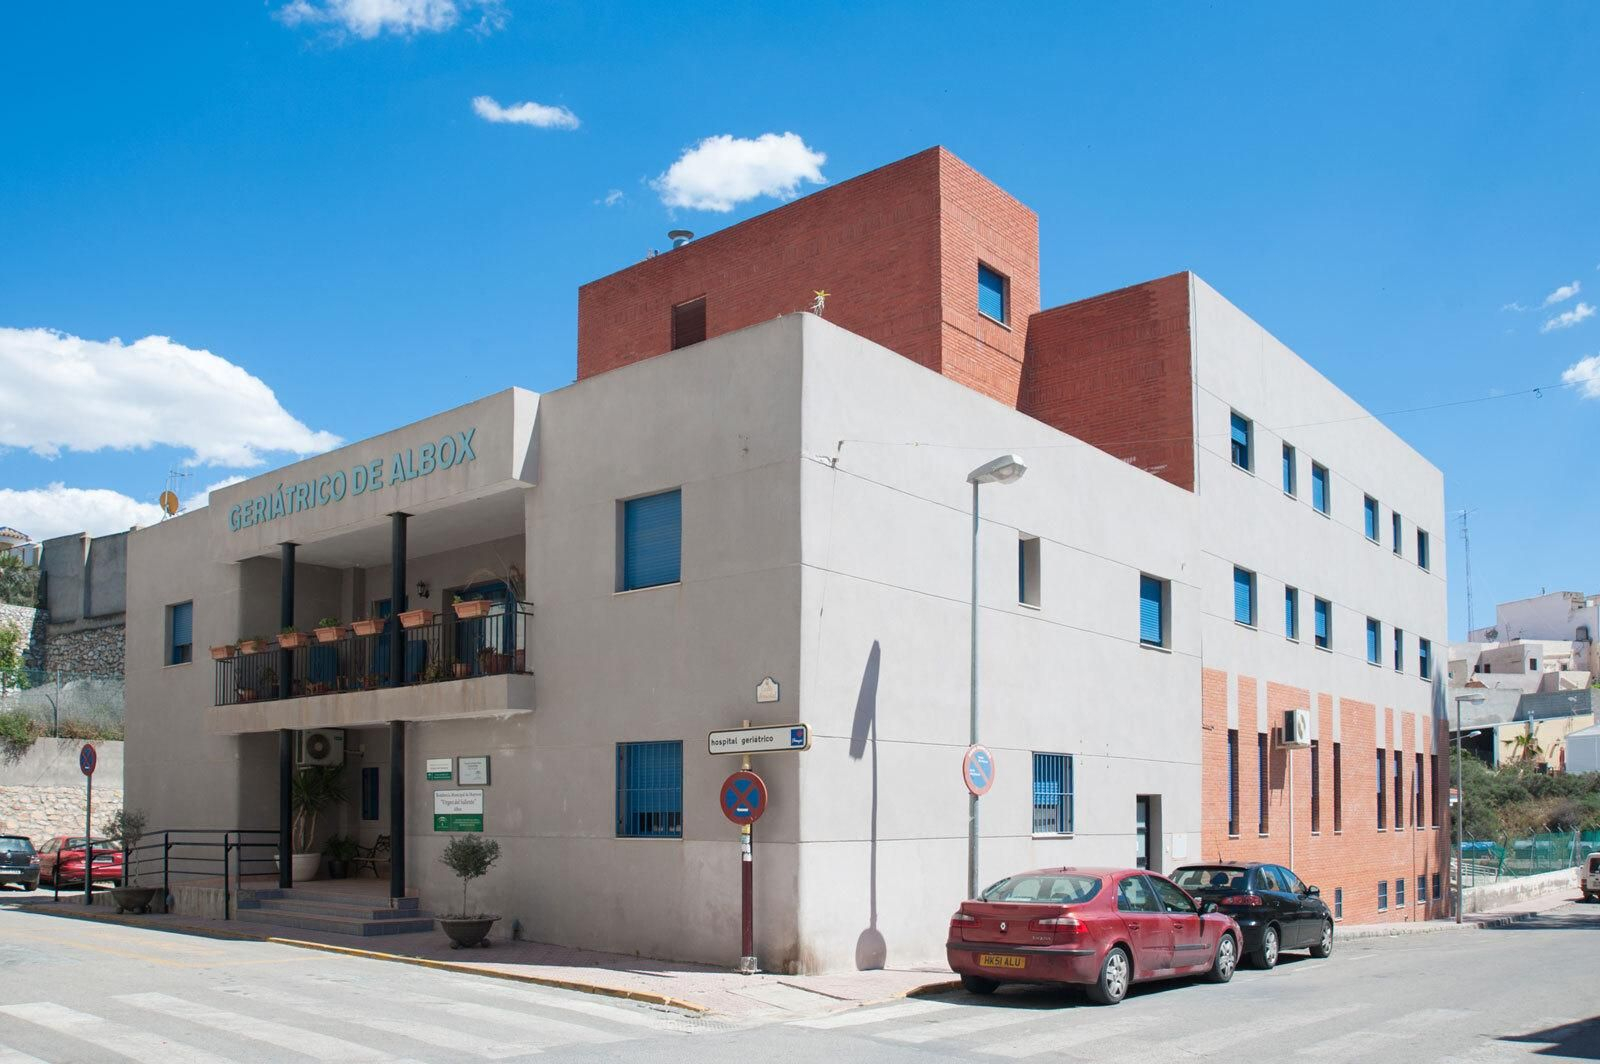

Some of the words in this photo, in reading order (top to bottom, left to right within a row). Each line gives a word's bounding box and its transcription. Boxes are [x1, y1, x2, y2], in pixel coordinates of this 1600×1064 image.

[228, 470, 347, 532] GERIÁTRICO
[351, 458, 384, 497] DE
[388, 428, 477, 487] ALBOX
[711, 737, 738, 746] hospital
[1004, 957, 1021, 967] ALU
